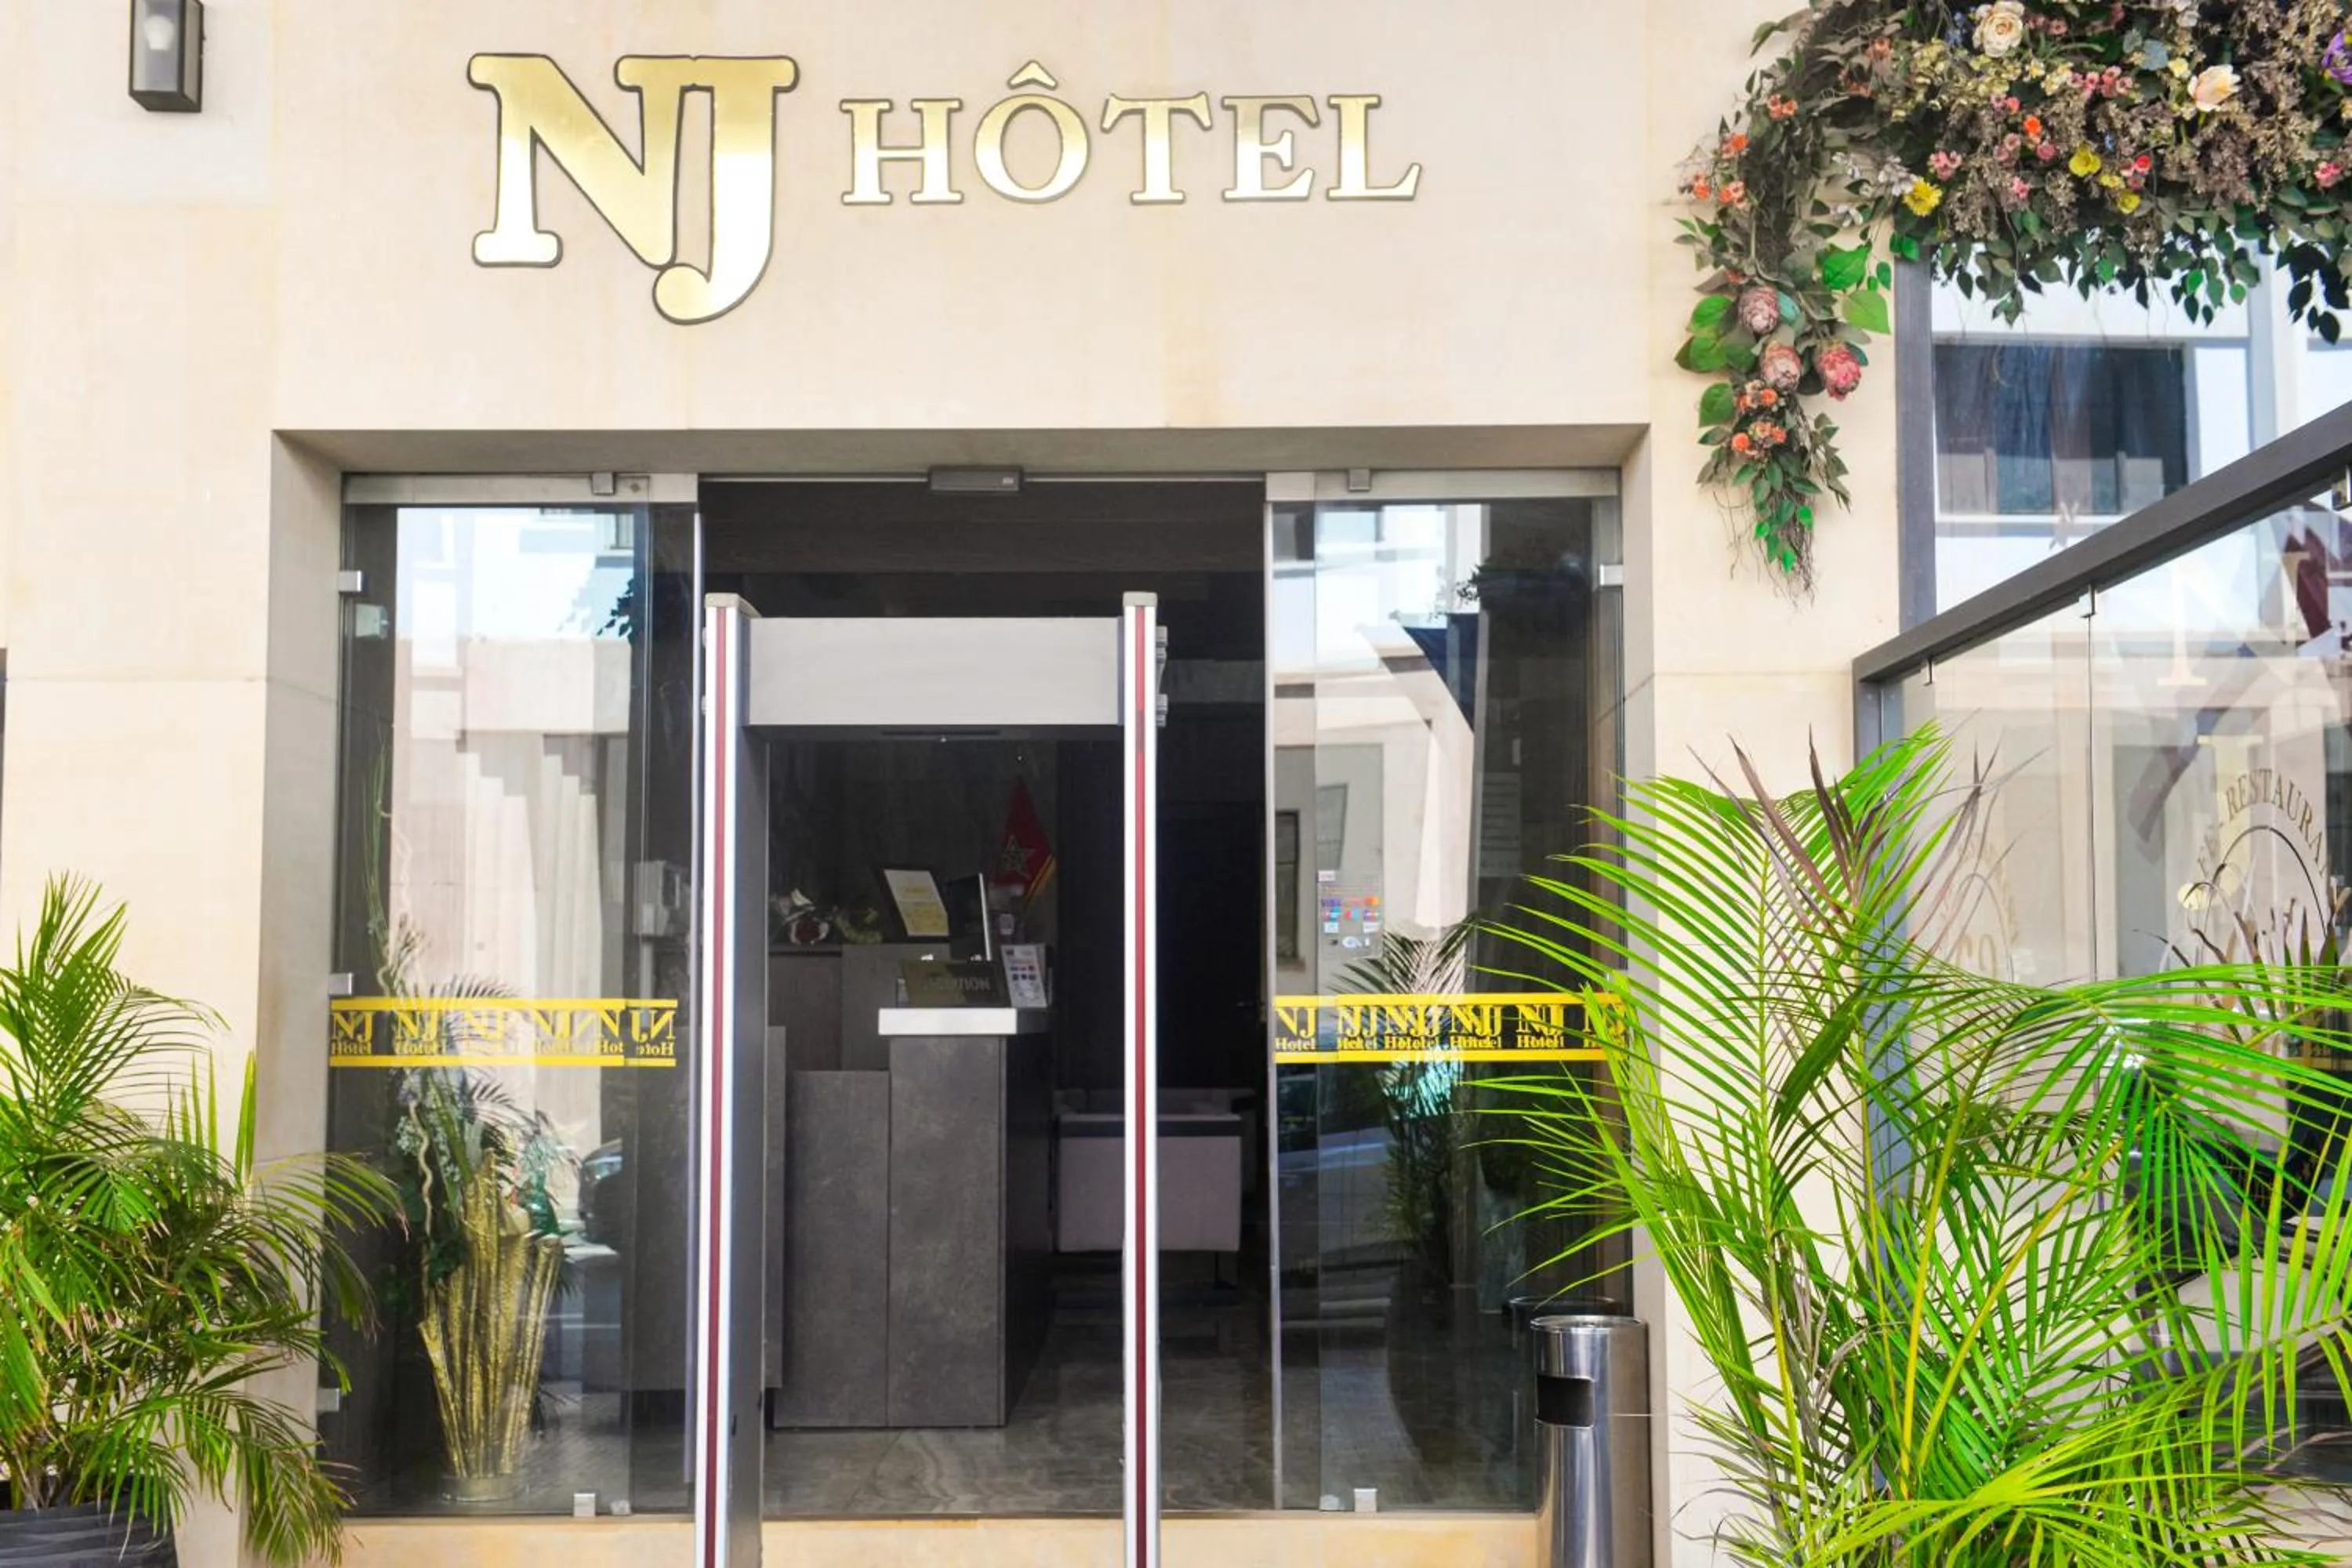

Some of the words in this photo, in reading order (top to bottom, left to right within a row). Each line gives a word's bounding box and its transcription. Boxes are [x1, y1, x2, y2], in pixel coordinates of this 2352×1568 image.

[468, 54, 799, 325] NJ
[839, 60, 1422, 204] HÔTEL
[2224, 768, 2328, 877] RESTAURA
[332, 1010, 374, 1042] NJ
[1274, 1037, 1317, 1051] Hotel
